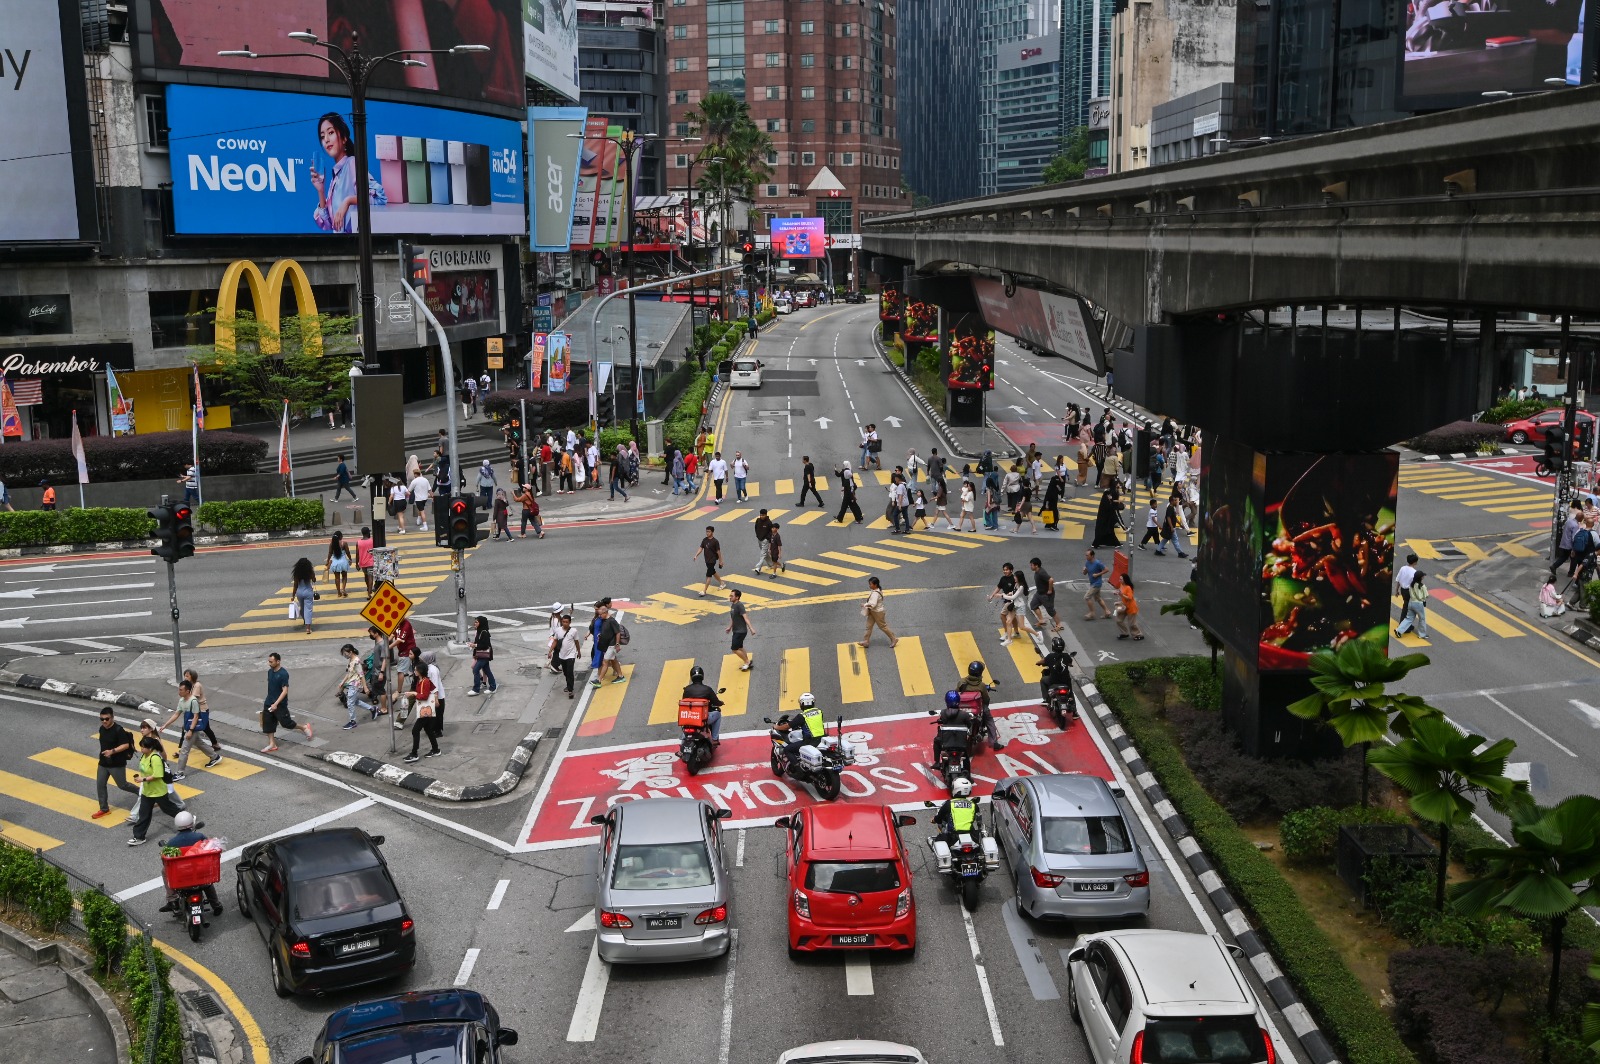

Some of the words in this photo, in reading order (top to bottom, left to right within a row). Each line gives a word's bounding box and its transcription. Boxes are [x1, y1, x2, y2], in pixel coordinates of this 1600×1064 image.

[547, 155, 562, 213] acer
[430, 250, 492, 268] GIORDANO
[2, 353, 100, 376] Pasembor
